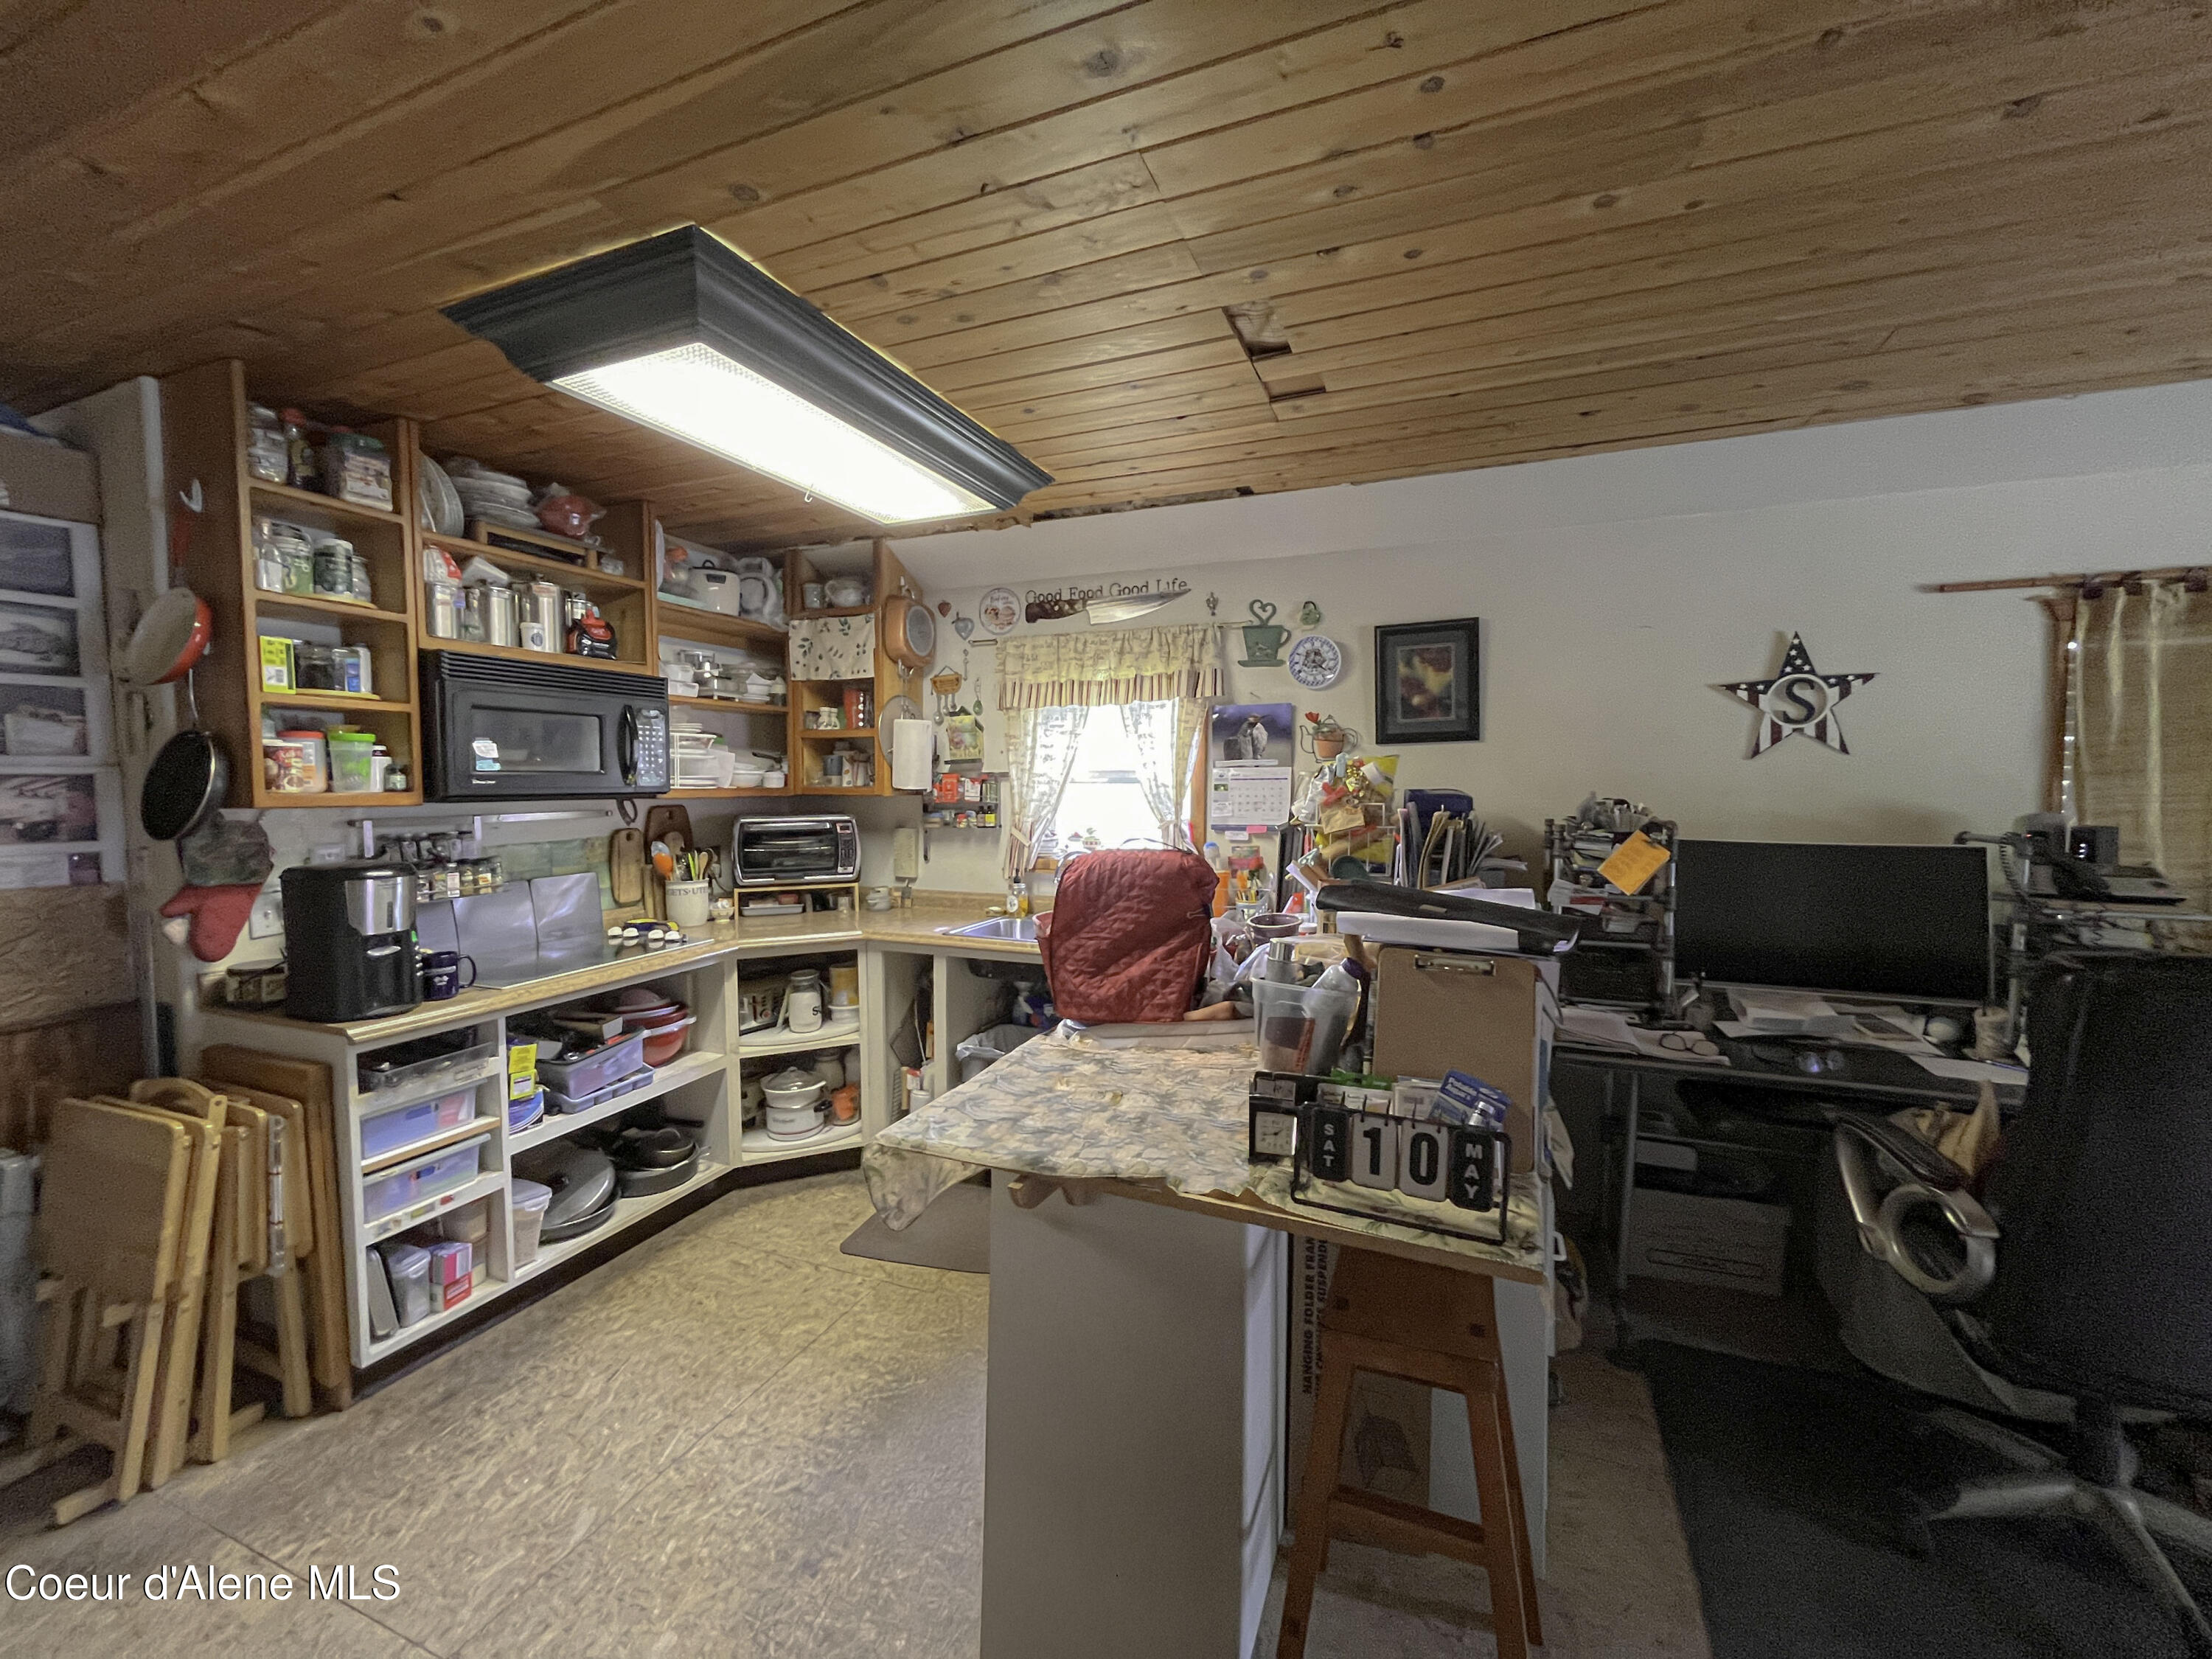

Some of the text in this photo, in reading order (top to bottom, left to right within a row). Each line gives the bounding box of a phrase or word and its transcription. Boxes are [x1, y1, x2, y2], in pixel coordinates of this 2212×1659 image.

[1026, 588, 1062, 604] Good
[1068, 585, 1102, 599] Food
[1109, 580, 1148, 597] Good
[1786, 678, 1815, 724] S
[1323, 1123, 1336, 1167] SAT
[1464, 1143, 1484, 1200] MAY
[1304, 1274, 1315, 1325] FOLDER
